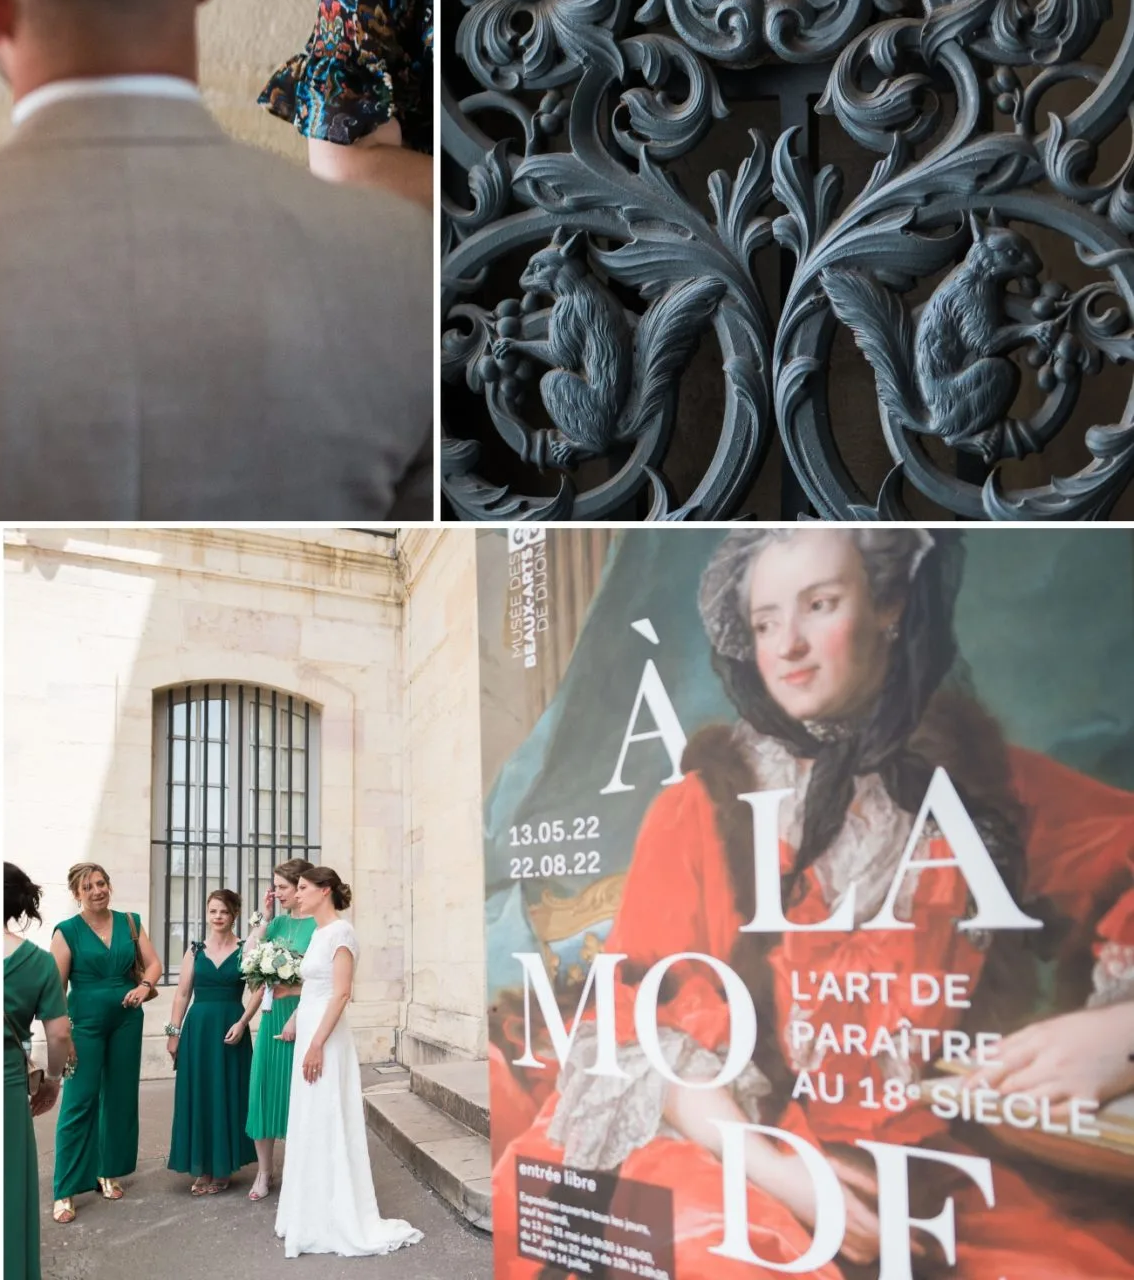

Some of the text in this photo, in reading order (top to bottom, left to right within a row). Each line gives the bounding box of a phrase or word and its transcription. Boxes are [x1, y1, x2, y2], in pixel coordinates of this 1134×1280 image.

[509, 552, 523, 658] MUSÉE DES
[521, 546, 537, 668] BEAUX-ARTS
[534, 541, 549, 632] DE DIJON
[599, 617, 689, 796] À
[508, 815, 600, 848] 13.05.22
[509, 851, 601, 881] 22.08.22
[737, 766, 1044, 933] LA
[512, 951, 758, 1091] MO
[791, 970, 971, 1010] L'ART DE
[791, 1019, 1003, 1067] PARAÎTRE
[791, 1071, 844, 1105] AU
[930, 1082, 1101, 1138] SIÈCLE
[518, 1163, 597, 1192] entrée libre
